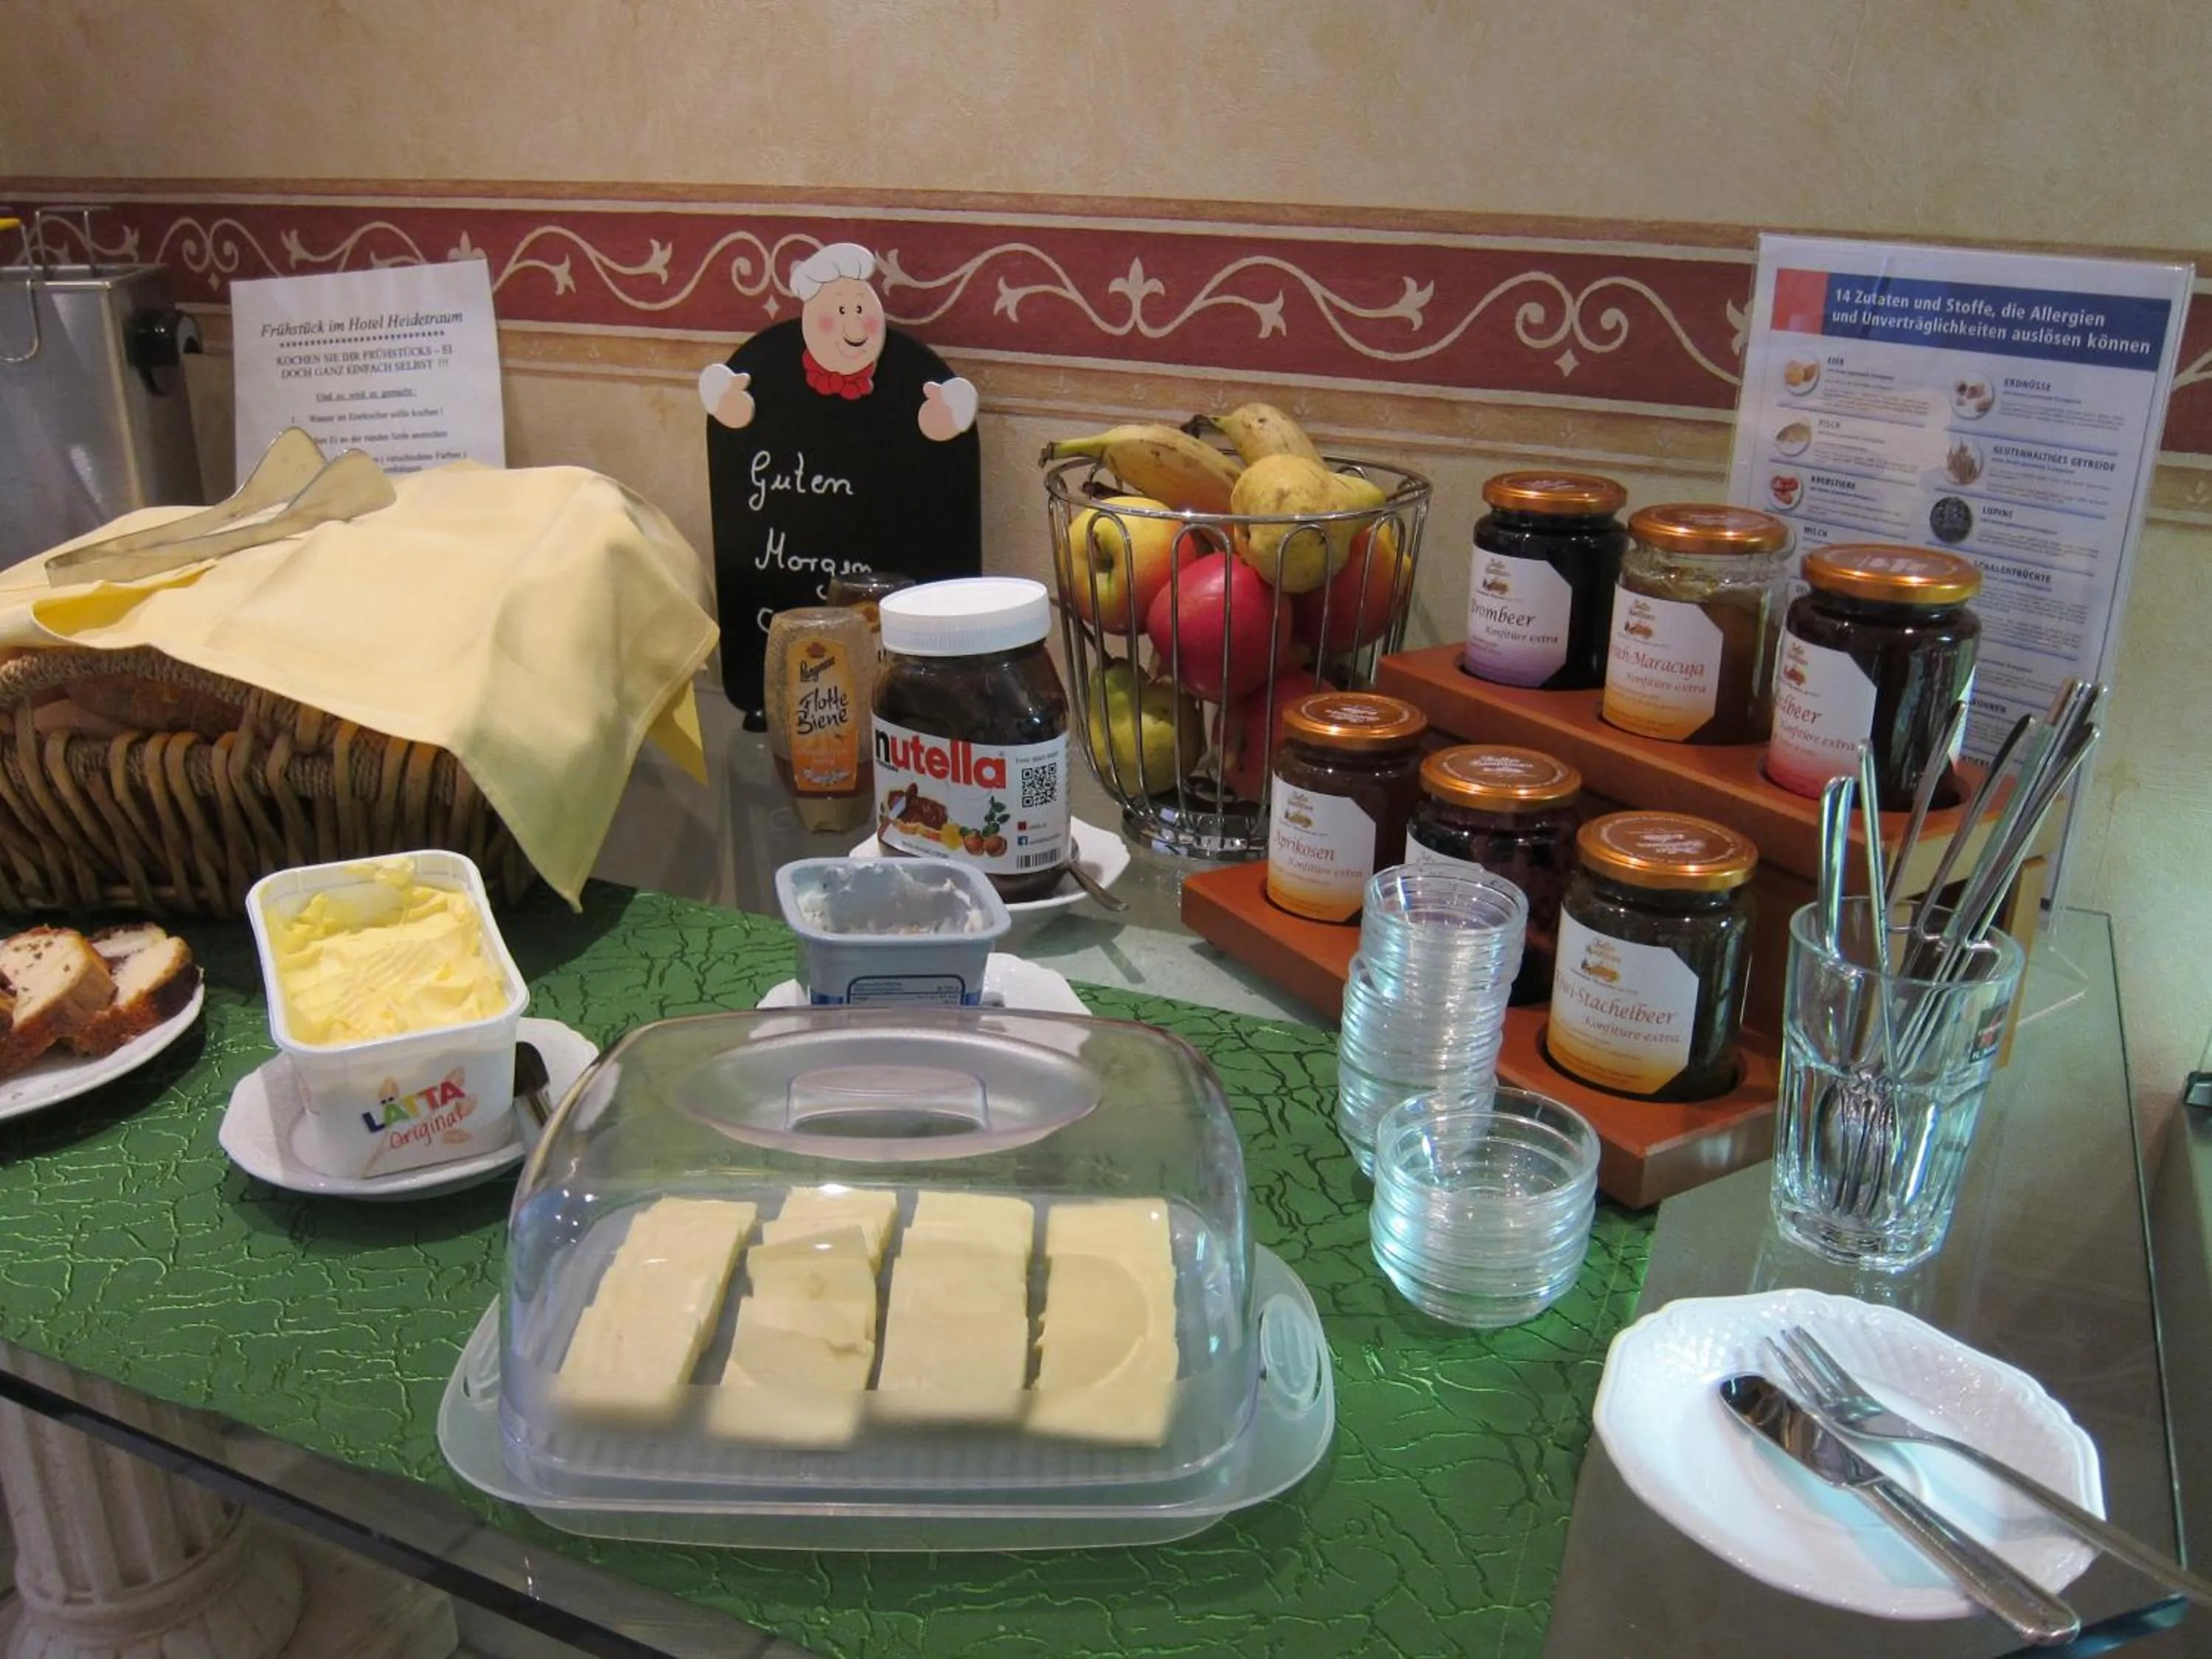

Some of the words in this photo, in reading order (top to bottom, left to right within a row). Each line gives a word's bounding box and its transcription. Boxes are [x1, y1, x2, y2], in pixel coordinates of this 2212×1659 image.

[1835, 288, 1851, 303] 14
[1854, 289, 1910, 308] Zutaten
[1913, 296, 1941, 312] und
[1946, 298, 1996, 319] Stoffe,
[2001, 302, 2026, 320] die
[2030, 305, 2107, 329] Allergien
[261, 319, 325, 338] Frühstück
[329, 320, 345, 333] im
[349, 315, 384, 332] Hotel
[388, 310, 464, 329] Heidetraum
[1832, 310, 1859, 324] und
[1862, 310, 2007, 341] Unverträglichkeiten
[2011, 327, 2081, 348] auslösen
[2087, 333, 2152, 355] können
[276, 354, 320, 366] KOCHEN
[281, 366, 313, 379] DOCH
[313, 364, 346, 377] GANZ
[2003, 377, 2052, 392] ERDNÜSSE
[1992, 445, 2068, 466] GLUTENHALTIGES
[2070, 456, 2116, 473] GETREIDE
[748, 450, 855, 511] Guten
[799, 686, 849, 713] Flotte
[796, 706, 849, 736] Biene
[874, 728, 1007, 790] nutella
[361, 1080, 466, 1134] LÄTTA
[390, 1107, 465, 1150] Original
